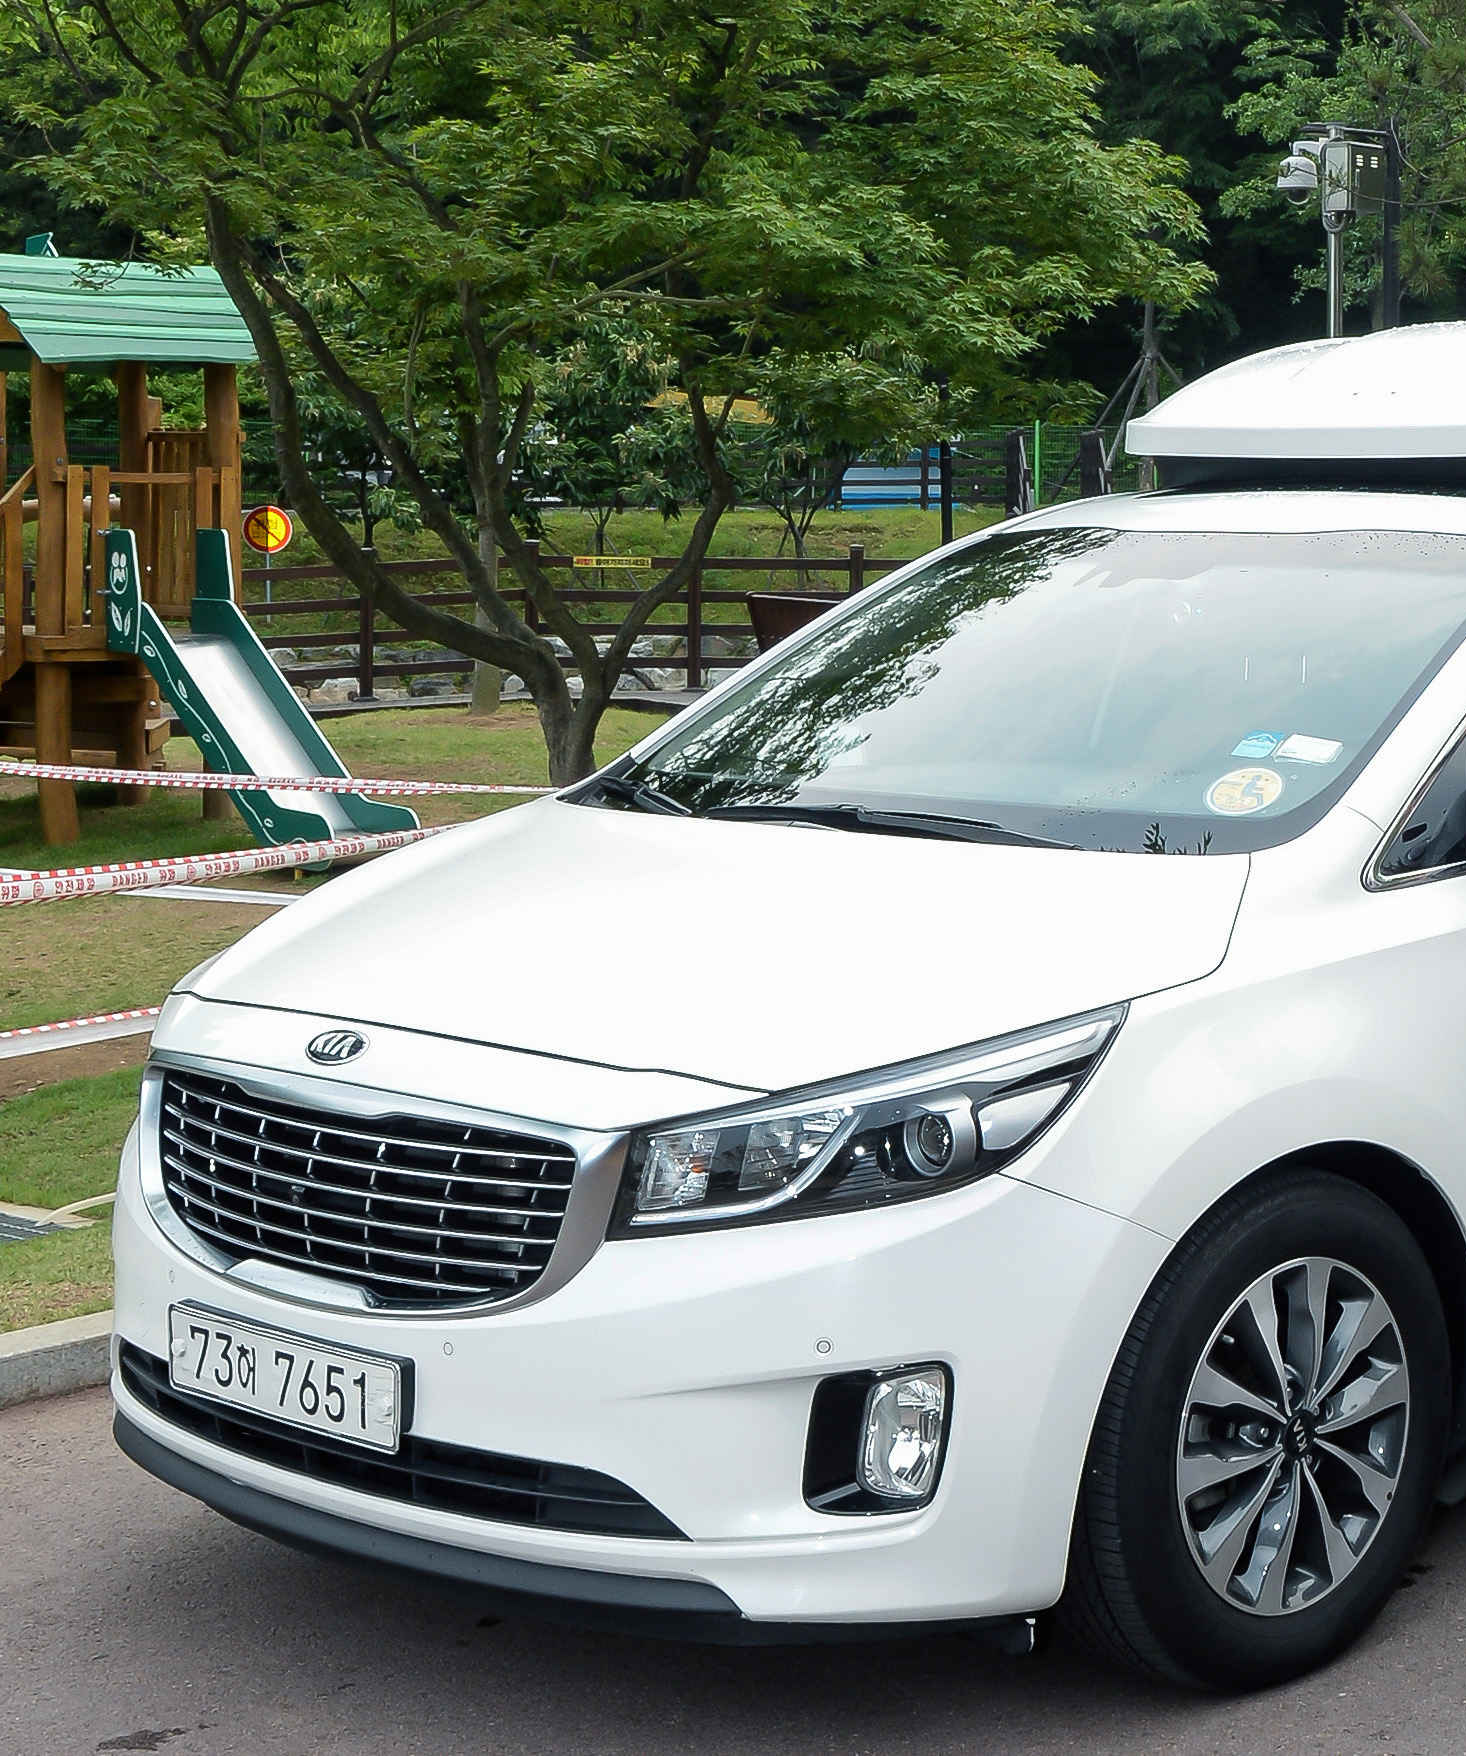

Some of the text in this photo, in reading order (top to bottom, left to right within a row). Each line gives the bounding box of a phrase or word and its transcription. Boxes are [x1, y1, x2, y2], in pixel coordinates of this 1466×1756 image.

[310, 1032, 357, 1059] KIA
[189, 1324, 368, 1430] 73허 7651
